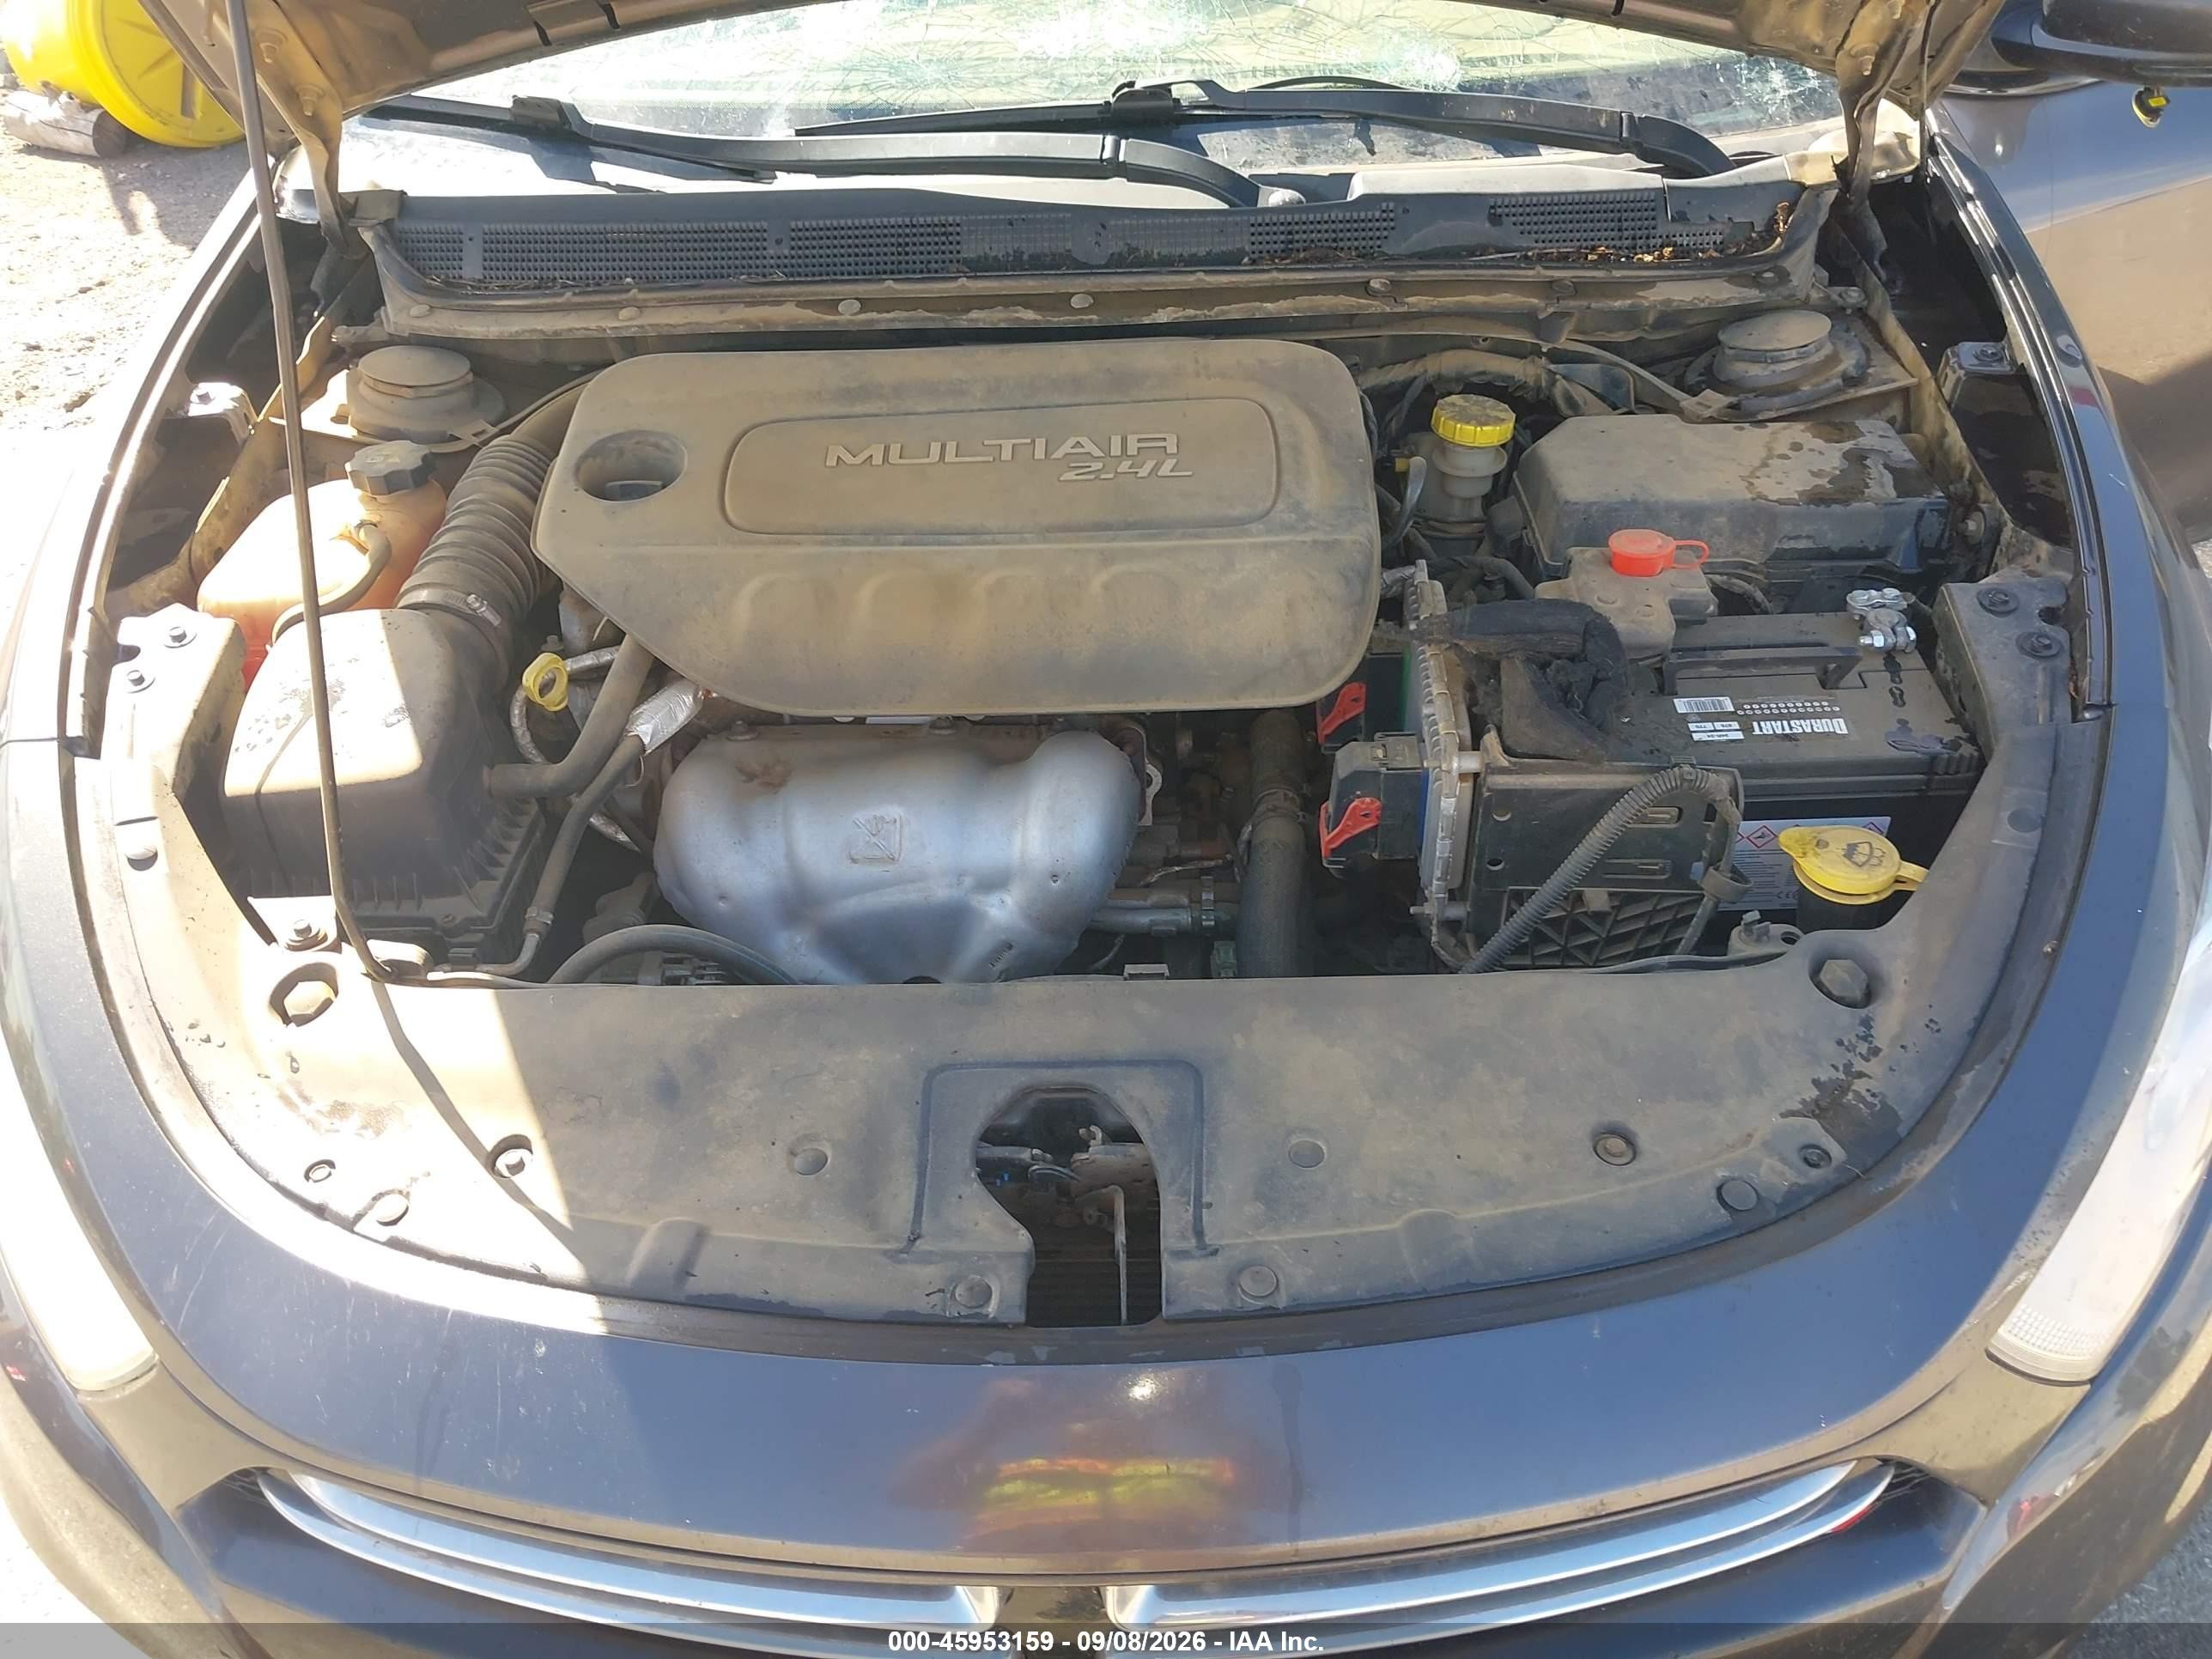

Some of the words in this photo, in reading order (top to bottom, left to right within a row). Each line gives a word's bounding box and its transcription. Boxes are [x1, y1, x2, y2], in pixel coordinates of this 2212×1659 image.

[825, 433, 1178, 467] MULTIAIR
[1058, 459, 1194, 482] 2.4L
[1752, 718, 1849, 735] DURASTART
